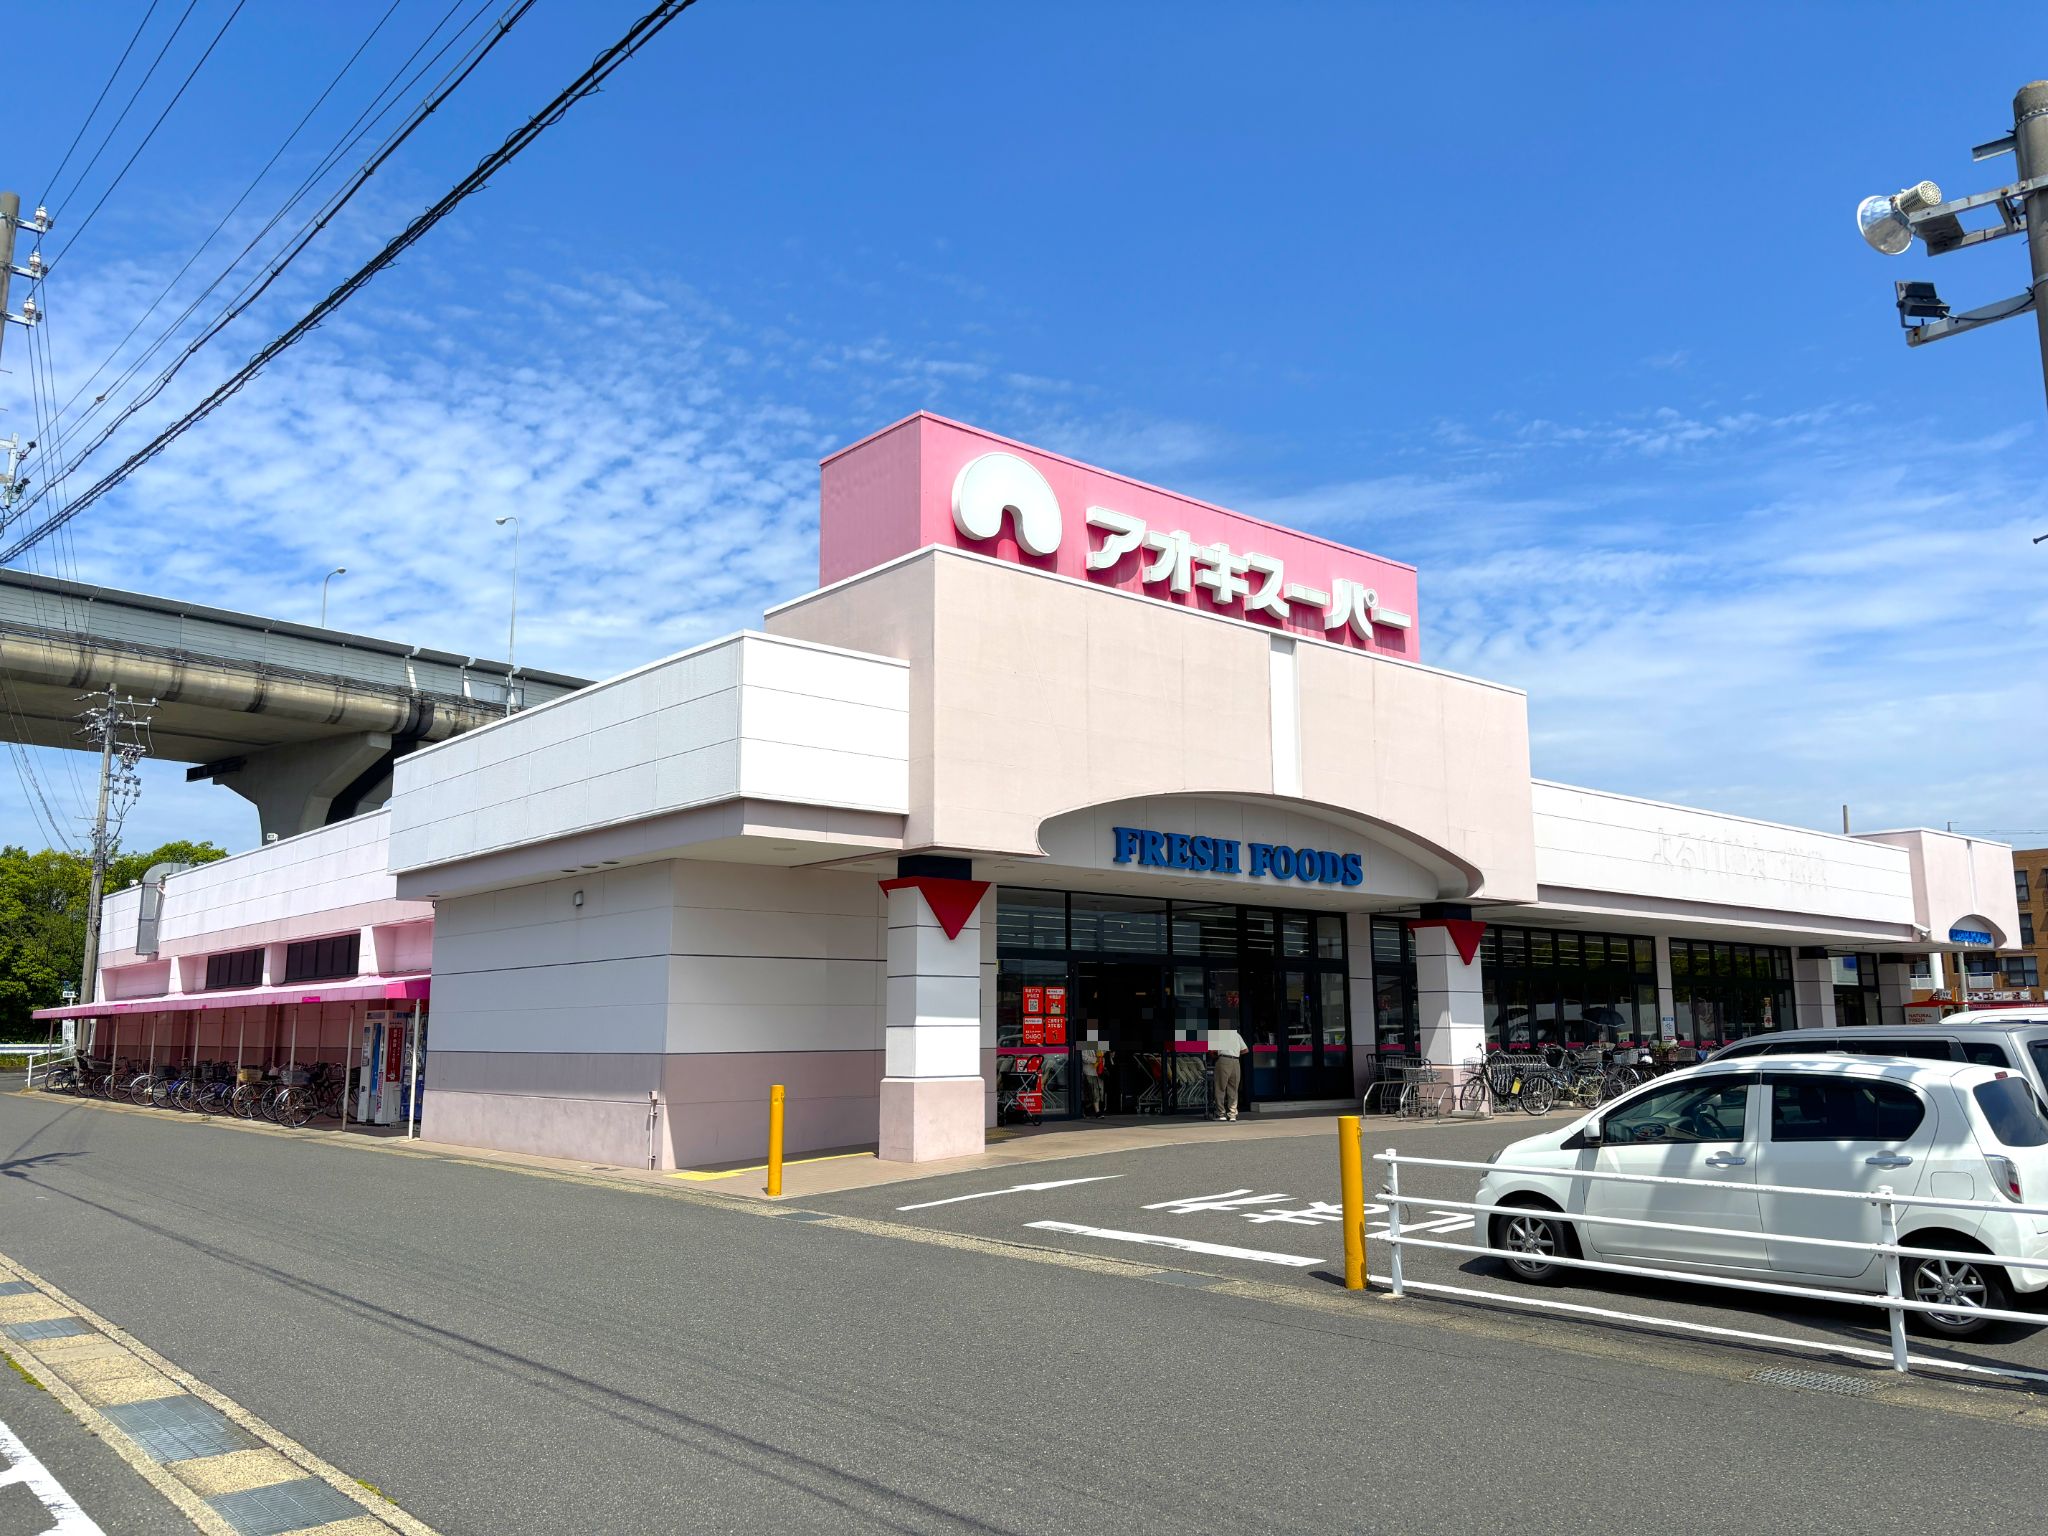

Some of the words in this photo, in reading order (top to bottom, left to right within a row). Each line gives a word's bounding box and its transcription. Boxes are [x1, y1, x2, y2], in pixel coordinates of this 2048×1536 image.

[1086, 506, 1411, 640] アオキスーパー
[1113, 827, 1242, 874] FRESH
[1249, 842, 1363, 886] FOODS
